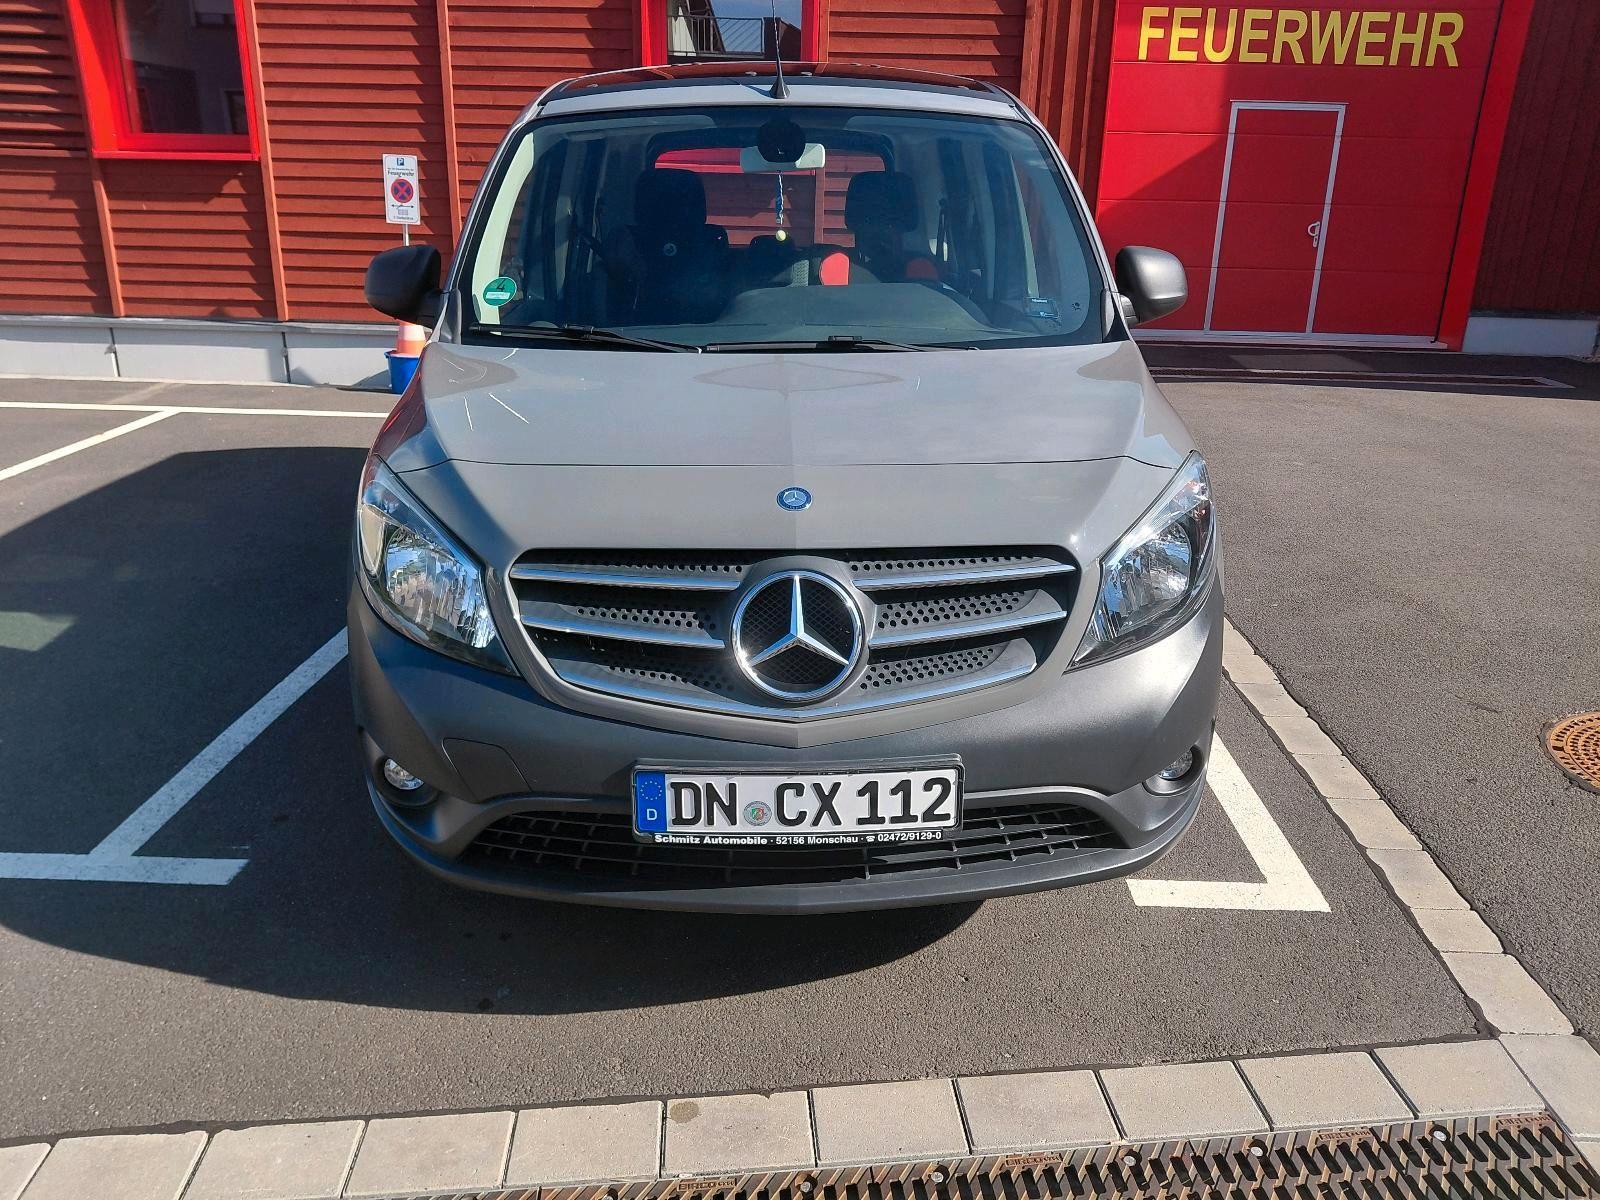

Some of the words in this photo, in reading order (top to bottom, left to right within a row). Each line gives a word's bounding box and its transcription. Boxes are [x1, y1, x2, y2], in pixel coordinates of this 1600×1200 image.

[1138, 6, 1464, 67] FEUERWEHR
[496, 279, 505, 292] 4
[670, 782, 737, 827] DN
[775, 782, 843, 827] CX
[856, 777, 951, 825] 112
[646, 808, 658, 820] D
[655, 835, 700, 844] Schmitz
[703, 836, 768, 845] Automobile
[775, 836, 805, 845] 52156
[807, 836, 859, 844] Monschau
[877, 832, 942, 842] 02472/9129-0
